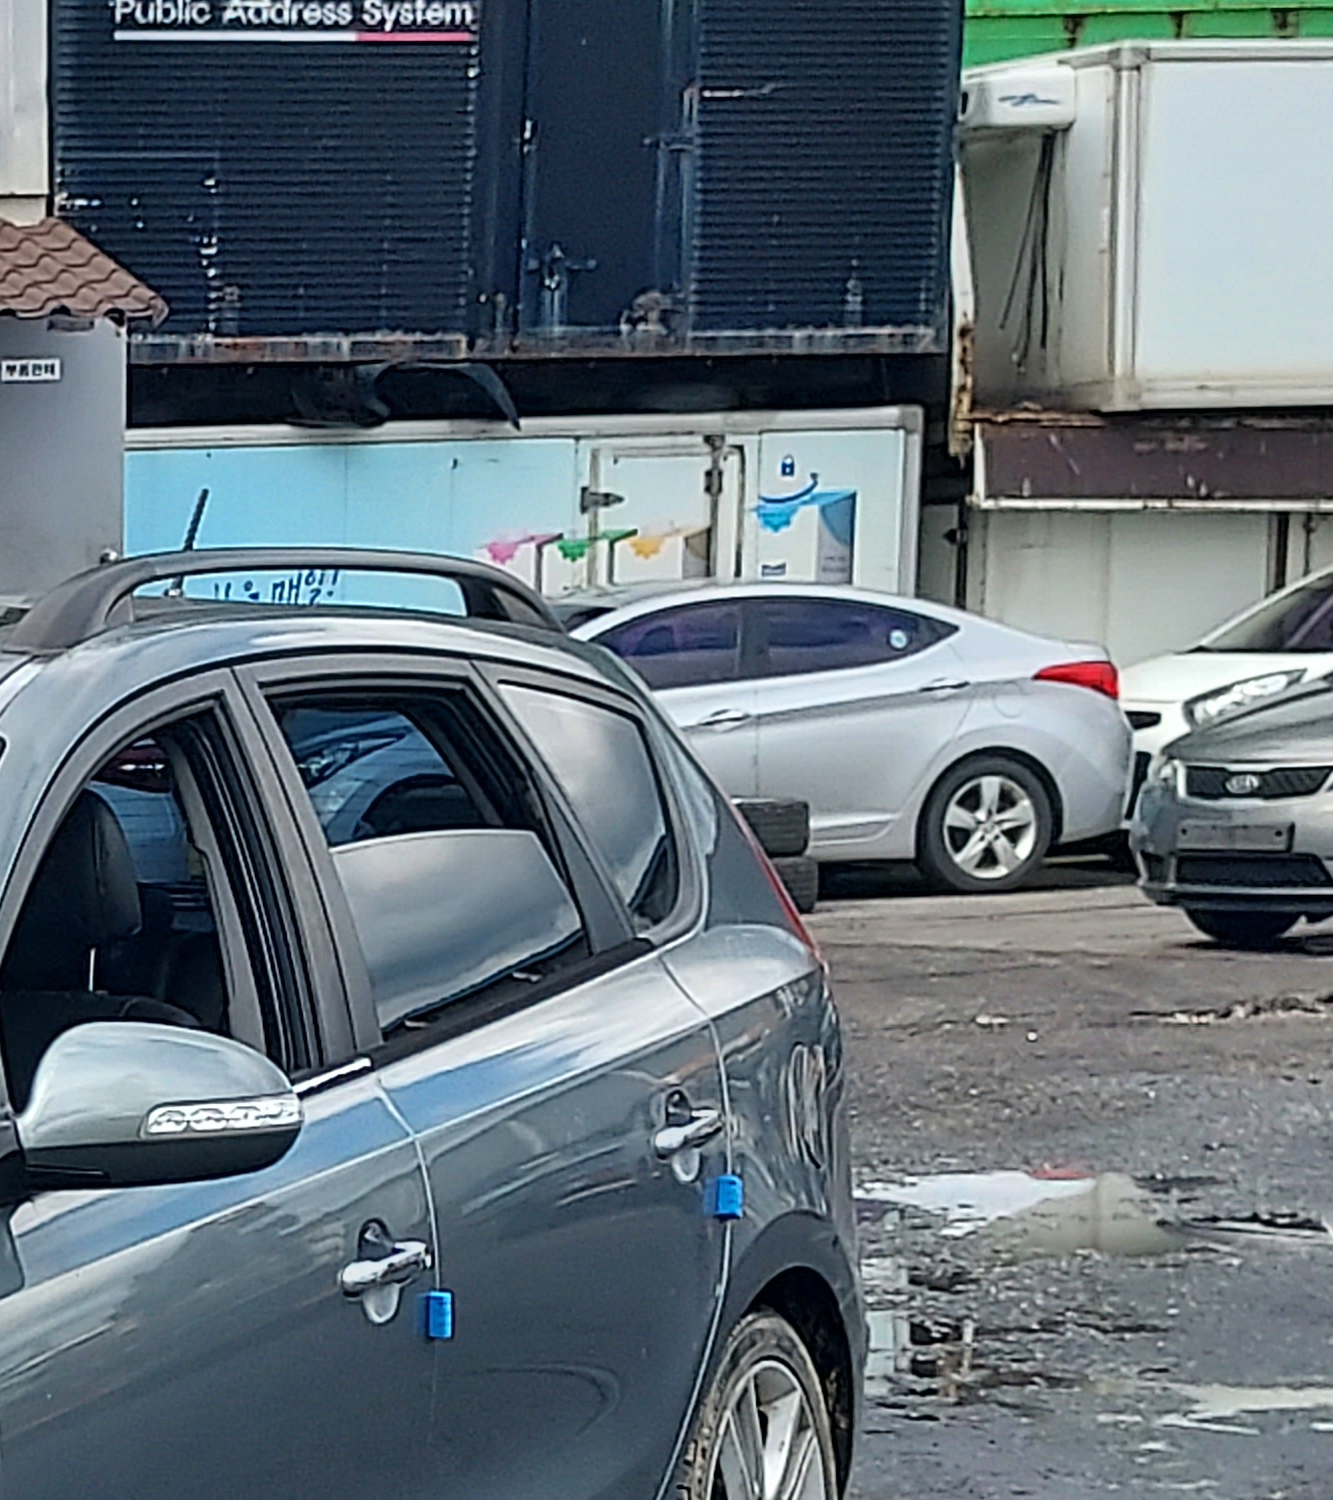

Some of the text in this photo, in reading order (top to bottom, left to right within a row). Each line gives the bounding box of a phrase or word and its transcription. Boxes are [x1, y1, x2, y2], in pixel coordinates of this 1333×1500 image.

[114, 0, 473, 32] Public Address System
